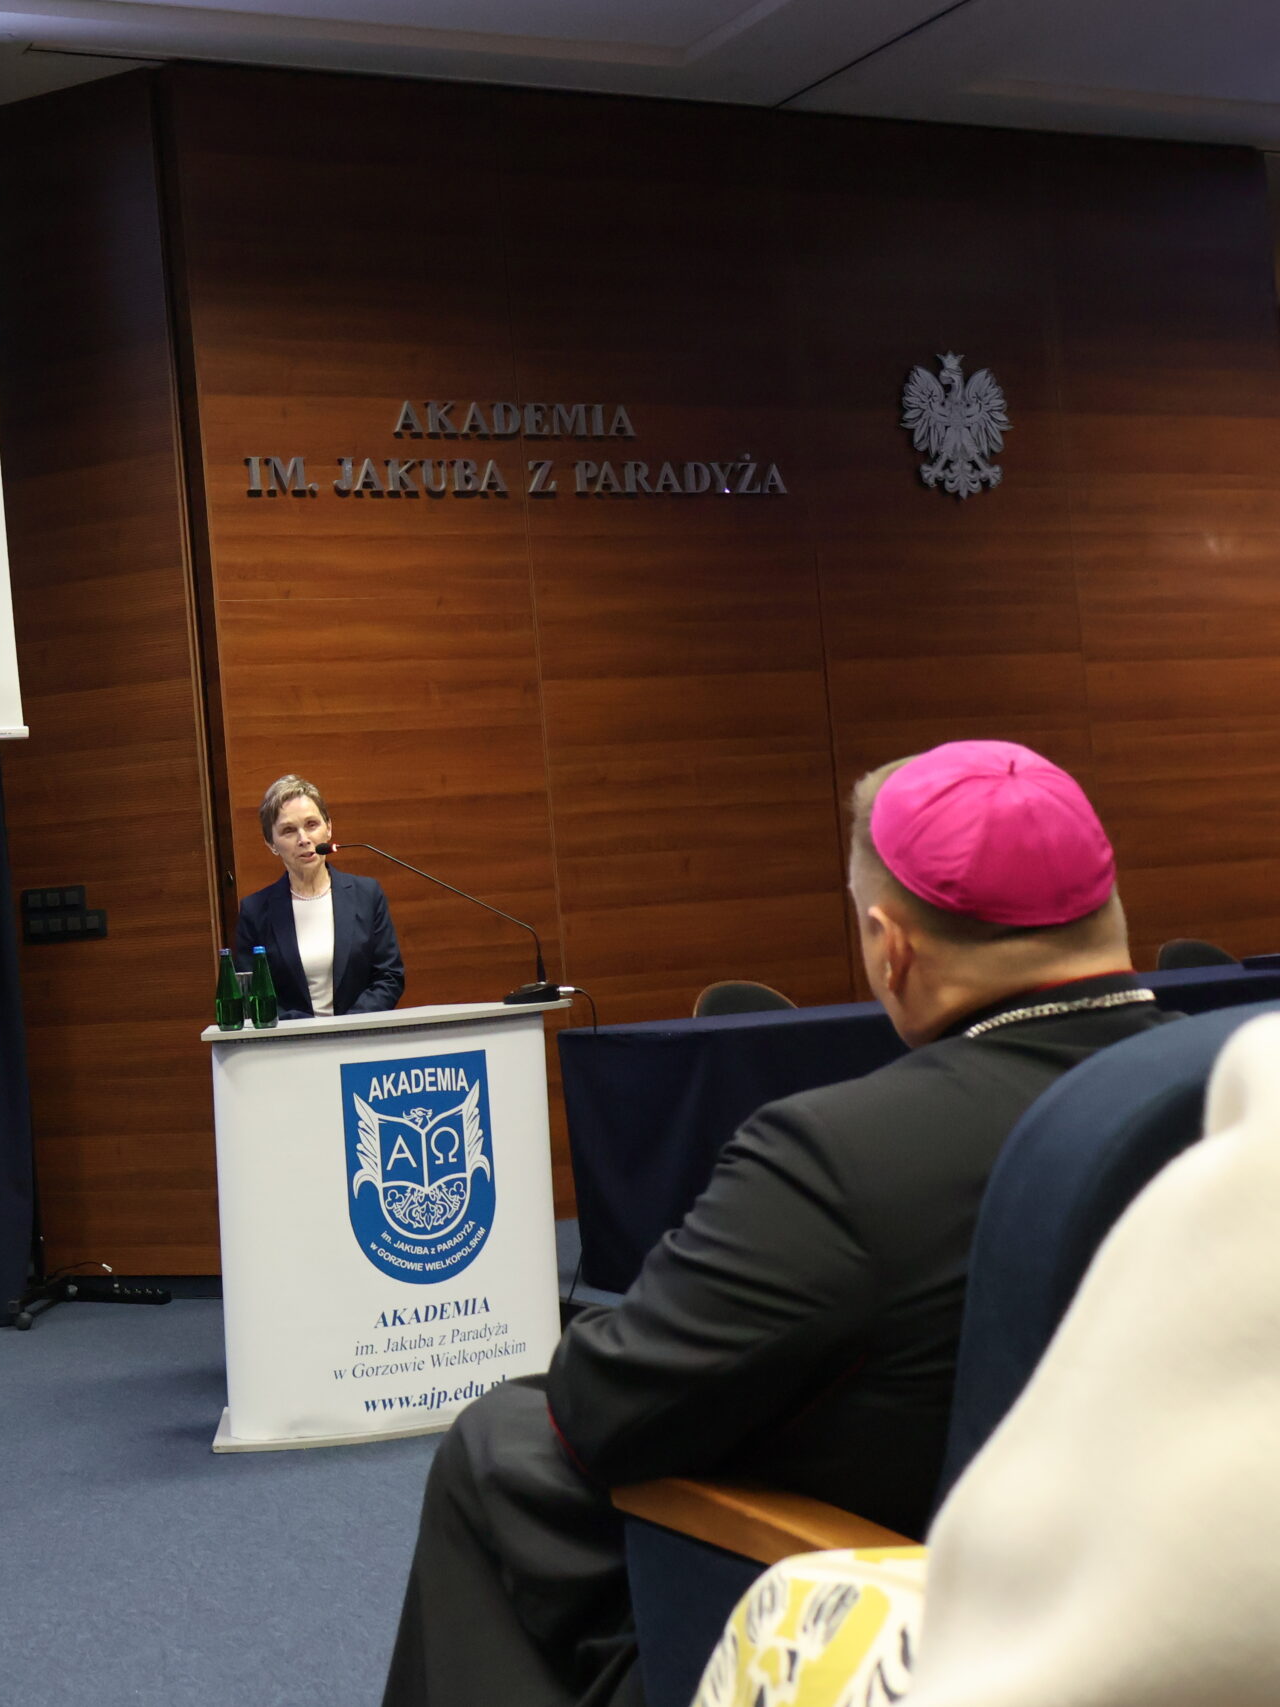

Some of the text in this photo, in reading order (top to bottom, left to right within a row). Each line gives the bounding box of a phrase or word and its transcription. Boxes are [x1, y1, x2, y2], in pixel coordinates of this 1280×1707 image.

[393, 400, 636, 438] AKADEMIA
[244, 453, 788, 498] IM. JAKUBA Z PARADYŻA
[369, 1067, 469, 1102] AKADEMIA
[431, 1127, 459, 1164] Ω
[377, 1248, 423, 1271] GORZOWIE
[425, 1226, 486, 1271] WIELKOPOLSKIM
[381, 1230, 393, 1244] im.
[393, 1240, 429, 1255] JAKUBA
[437, 1220, 476, 1252] PARADYŻA
[374, 1296, 491, 1328] AKADEMIA
[354, 1322, 508, 1356] im. Jakuba z Paradyża
[333, 1339, 527, 1380] w Gorzowie Wielkopolskim
[364, 1374, 506, 1412] www.ajp.edu
